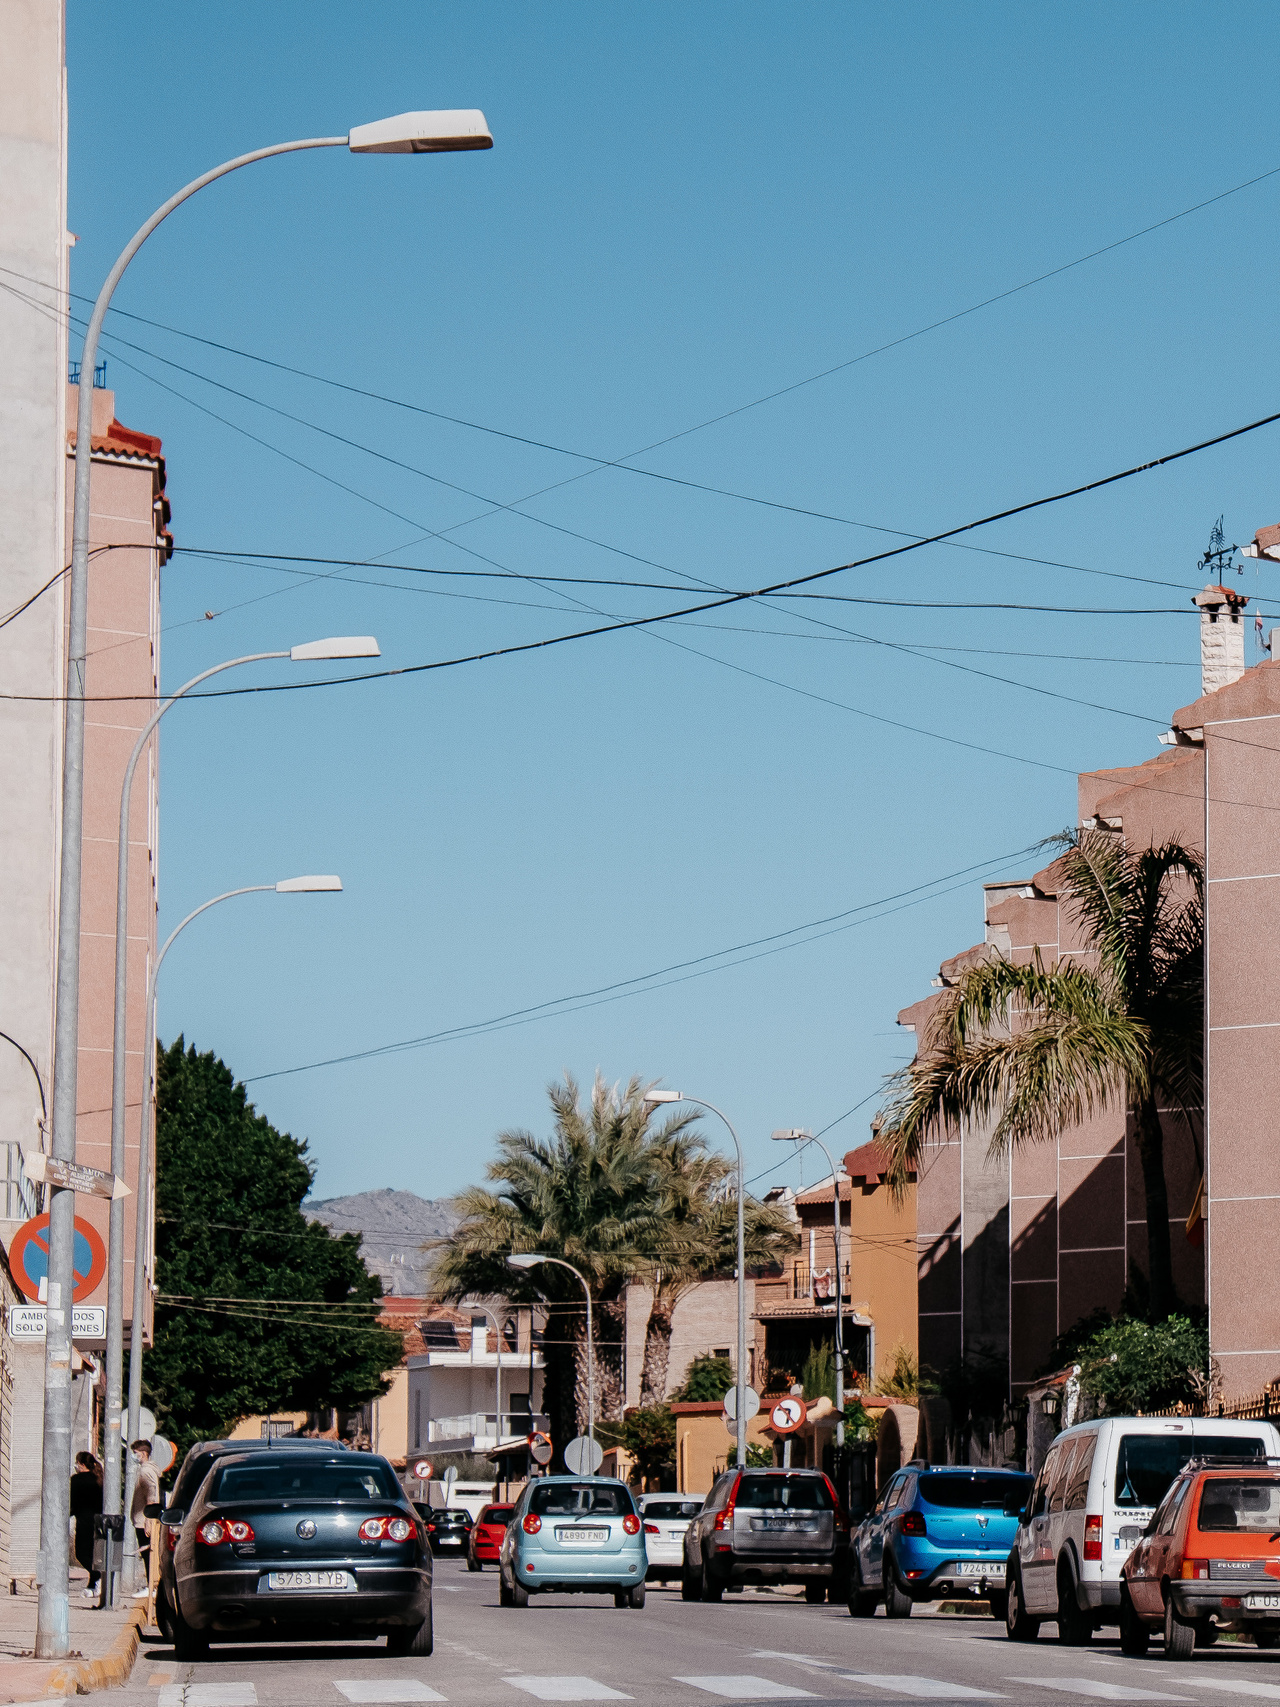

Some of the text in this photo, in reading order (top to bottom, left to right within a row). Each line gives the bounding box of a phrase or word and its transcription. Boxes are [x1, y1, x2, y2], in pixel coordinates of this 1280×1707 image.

[20, 1312, 95, 1320] AMB DOS
[15, 1324, 99, 1332] SOLO ONES
[564, 1531, 604, 1540] 4890 FND
[963, 1564, 987, 1573] 7246
[277, 1572, 343, 1585] 5763 FYB
